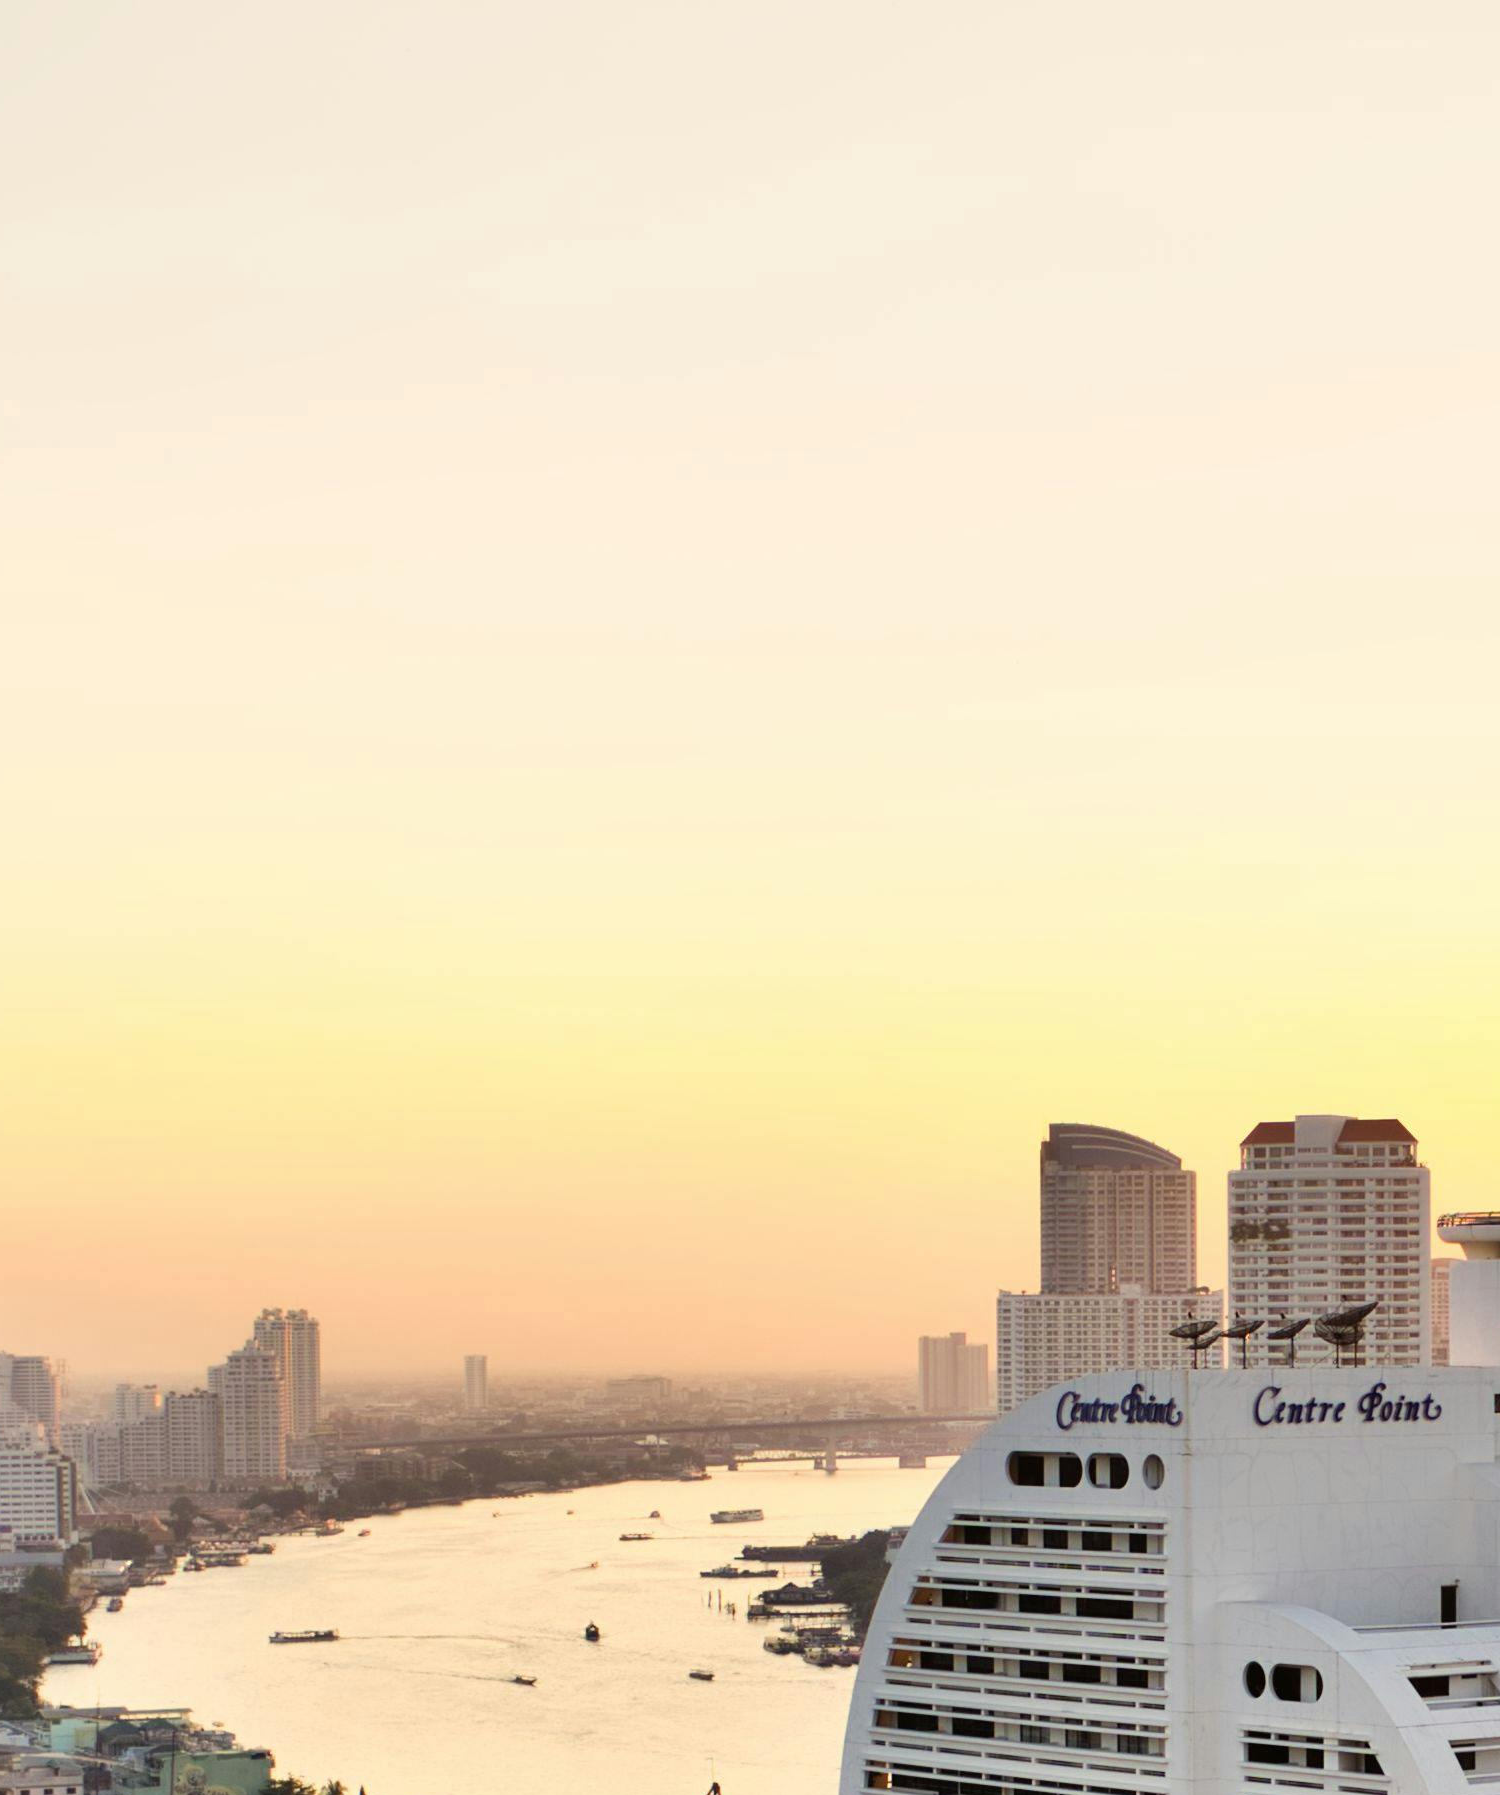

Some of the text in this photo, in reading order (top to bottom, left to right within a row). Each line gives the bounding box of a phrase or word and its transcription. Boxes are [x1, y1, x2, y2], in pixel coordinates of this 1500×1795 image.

[1056, 1384, 1183, 1431] Centre Point
[1253, 1382, 1442, 1427] Centre Point
